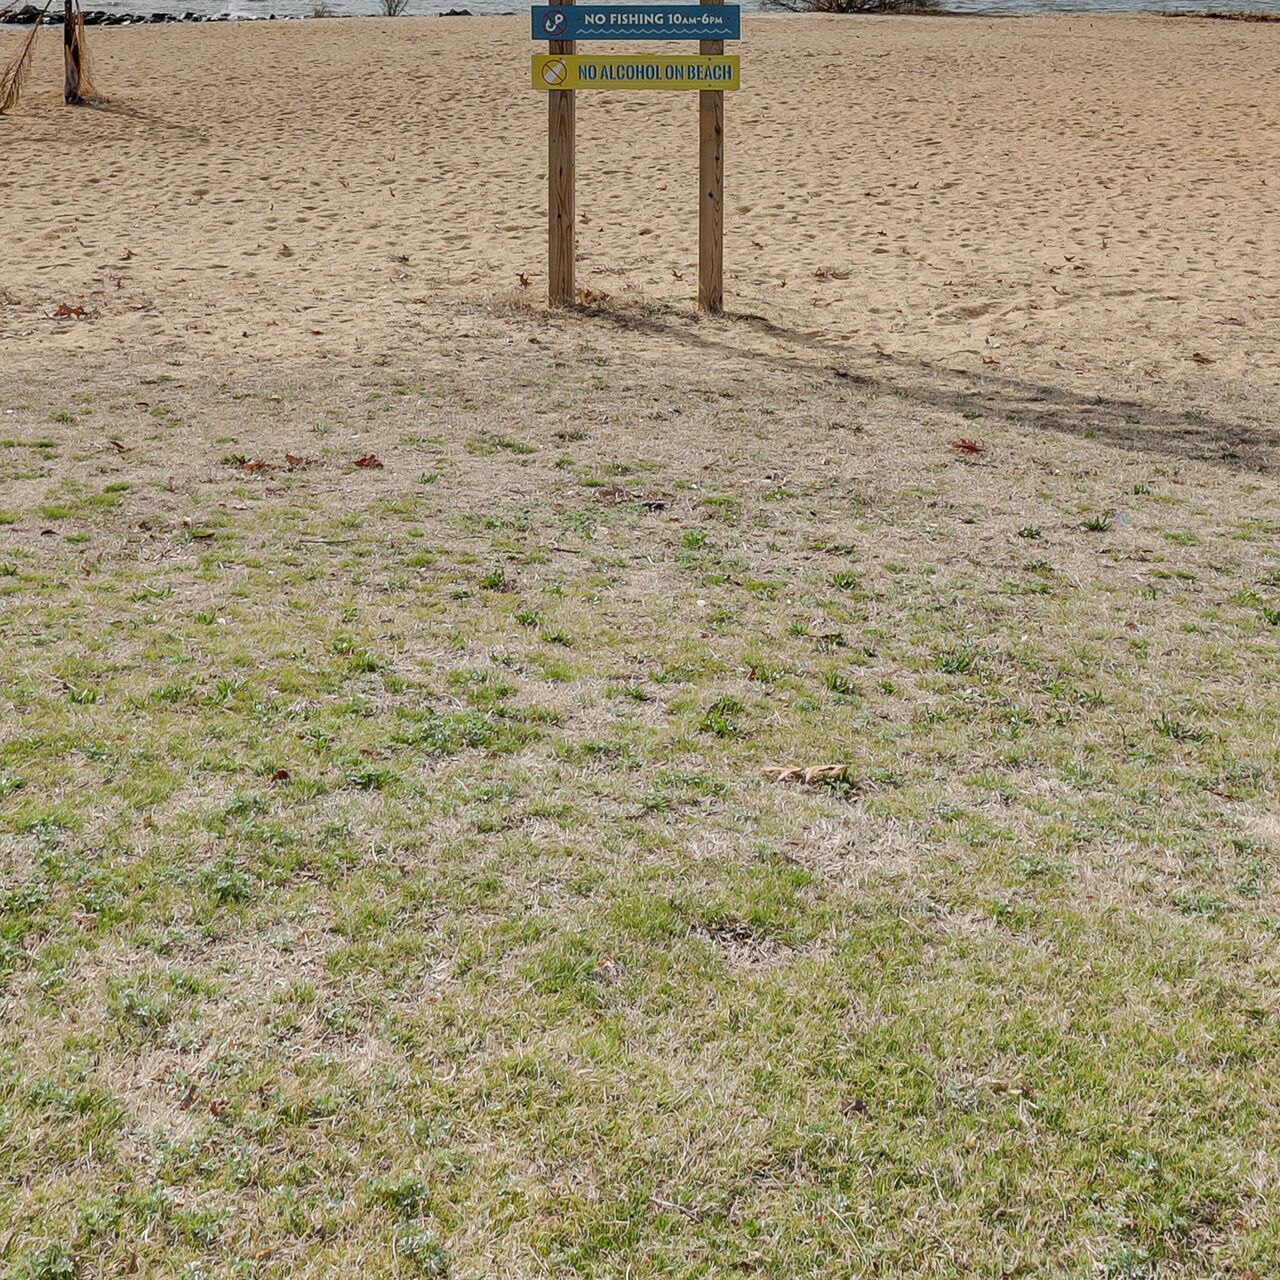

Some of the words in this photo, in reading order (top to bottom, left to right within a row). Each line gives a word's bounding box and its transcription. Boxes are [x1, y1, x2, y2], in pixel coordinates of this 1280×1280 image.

[584, 13, 606, 24] NO
[610, 13, 664, 25] FISHING
[578, 65, 597, 80] NO
[600, 64, 662, 80] ALCOHOL
[665, 64, 684, 80] ON
[687, 64, 733, 80] BEACH
